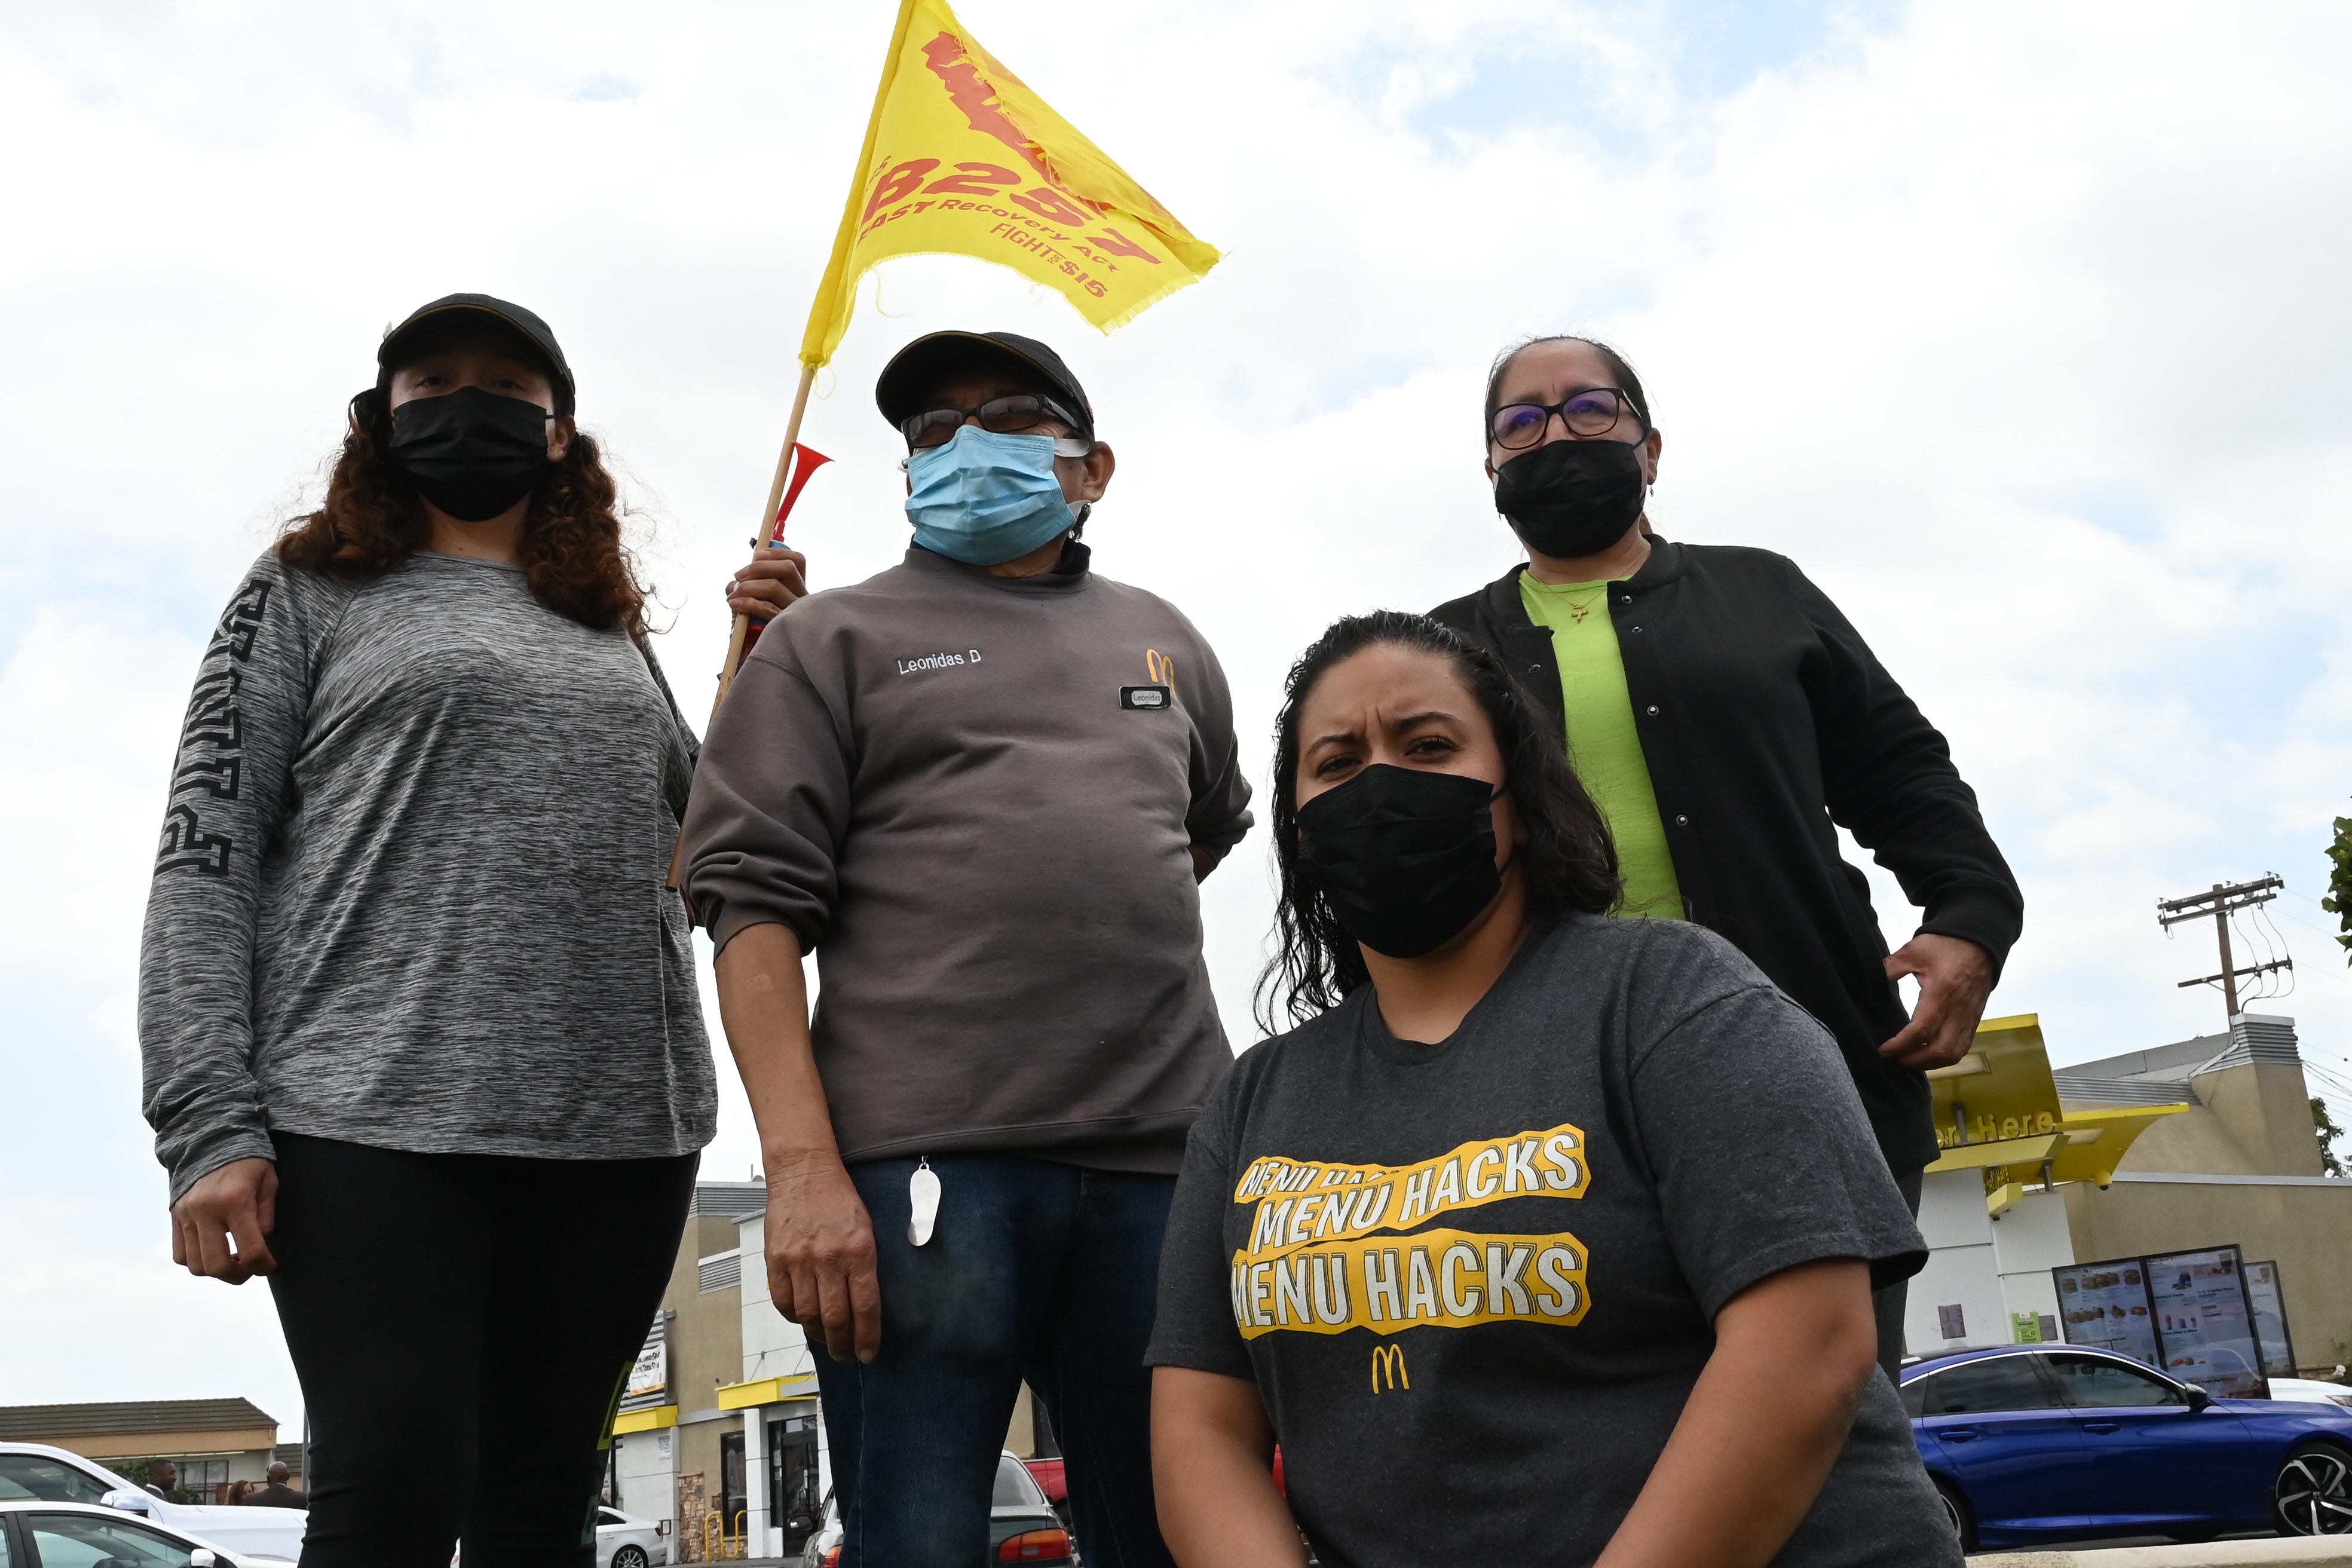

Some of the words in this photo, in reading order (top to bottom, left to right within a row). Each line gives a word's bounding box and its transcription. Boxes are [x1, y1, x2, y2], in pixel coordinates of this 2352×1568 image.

[855, 200, 937, 249] FAST
[937, 199, 1071, 240] Recovery
[990, 223, 1067, 259] FIGHT
[1059, 261, 1108, 298] $15
[898, 653, 964, 675] Leonidas
[969, 650, 981, 663] D
[1133, 693, 1160, 702] Leonidas
[1977, 1111, 2054, 1141] Here
[1252, 1181, 1394, 1256] MENU
[1398, 1131, 1583, 1222] HACKS
[1232, 1252, 1352, 1328] MENU
[1364, 1241, 1584, 1321] HACKS
